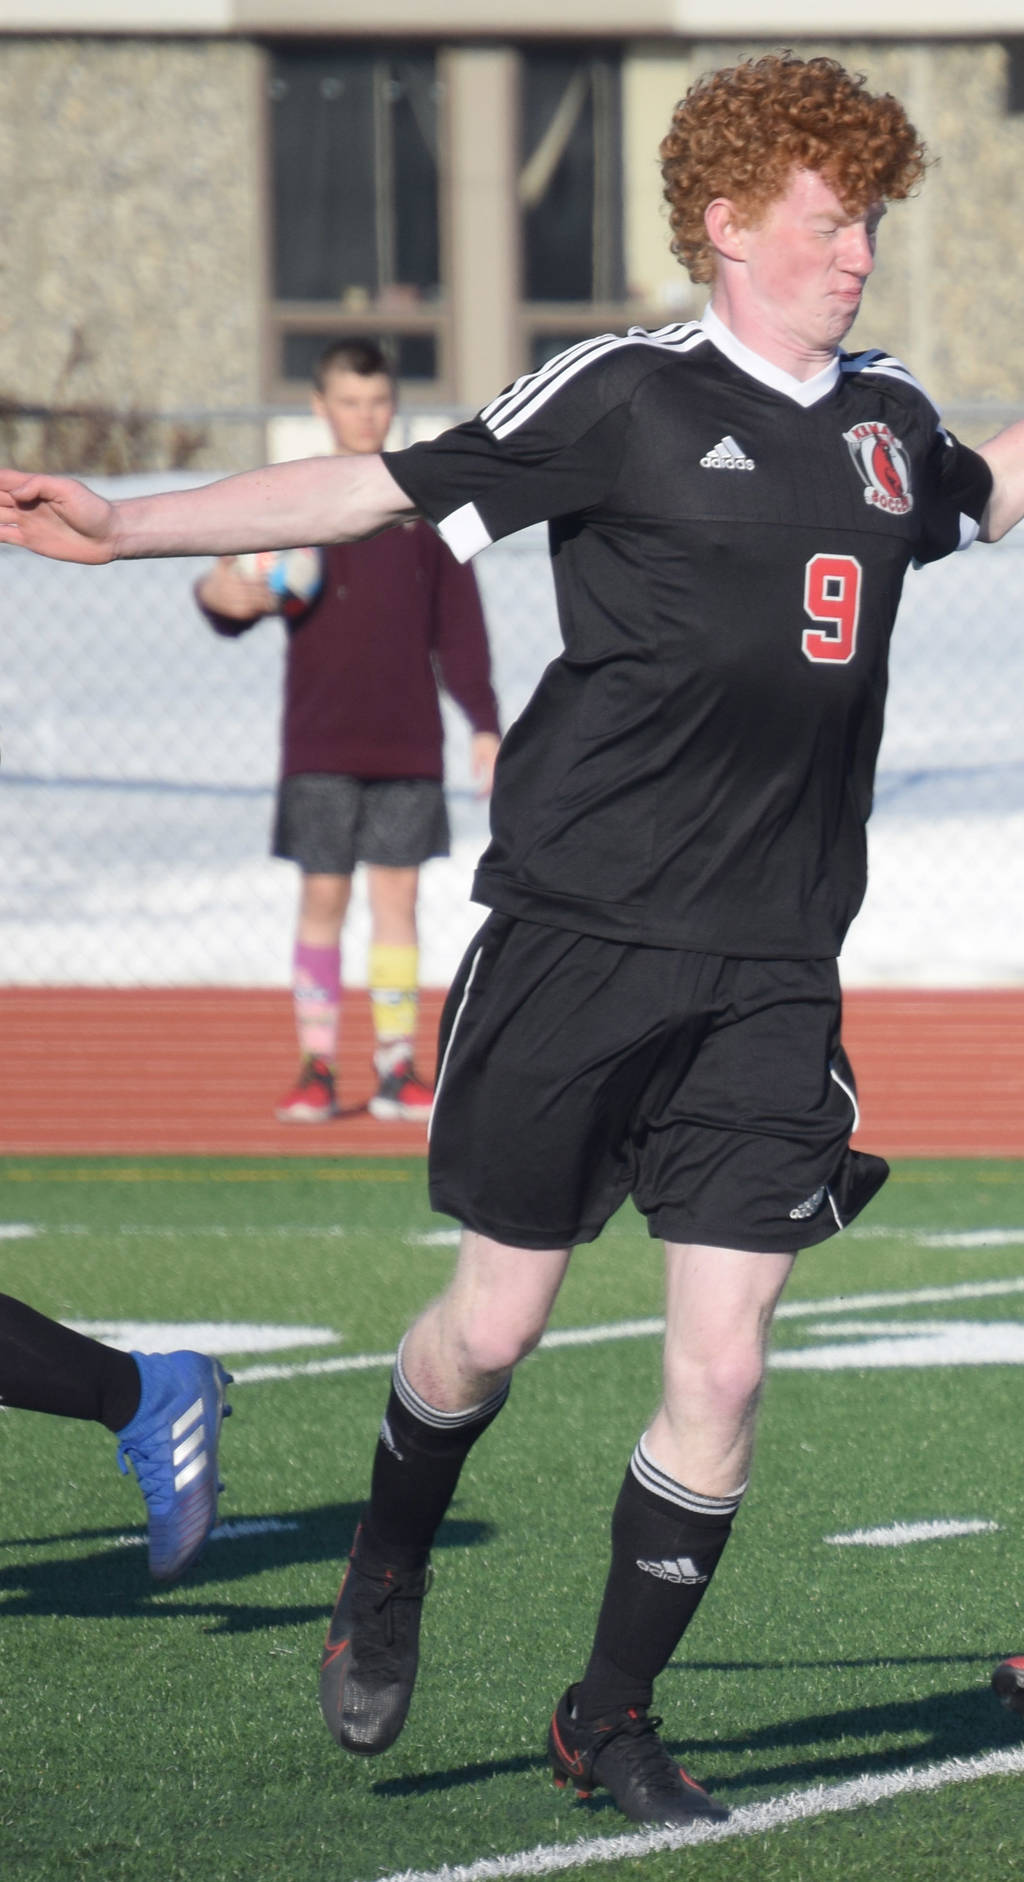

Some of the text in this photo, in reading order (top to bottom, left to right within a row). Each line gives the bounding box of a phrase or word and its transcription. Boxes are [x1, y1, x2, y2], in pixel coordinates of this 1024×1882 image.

[700, 456, 755, 470] adidas
[801, 552, 862, 664] 9
[636, 1559, 708, 1585] adidas
